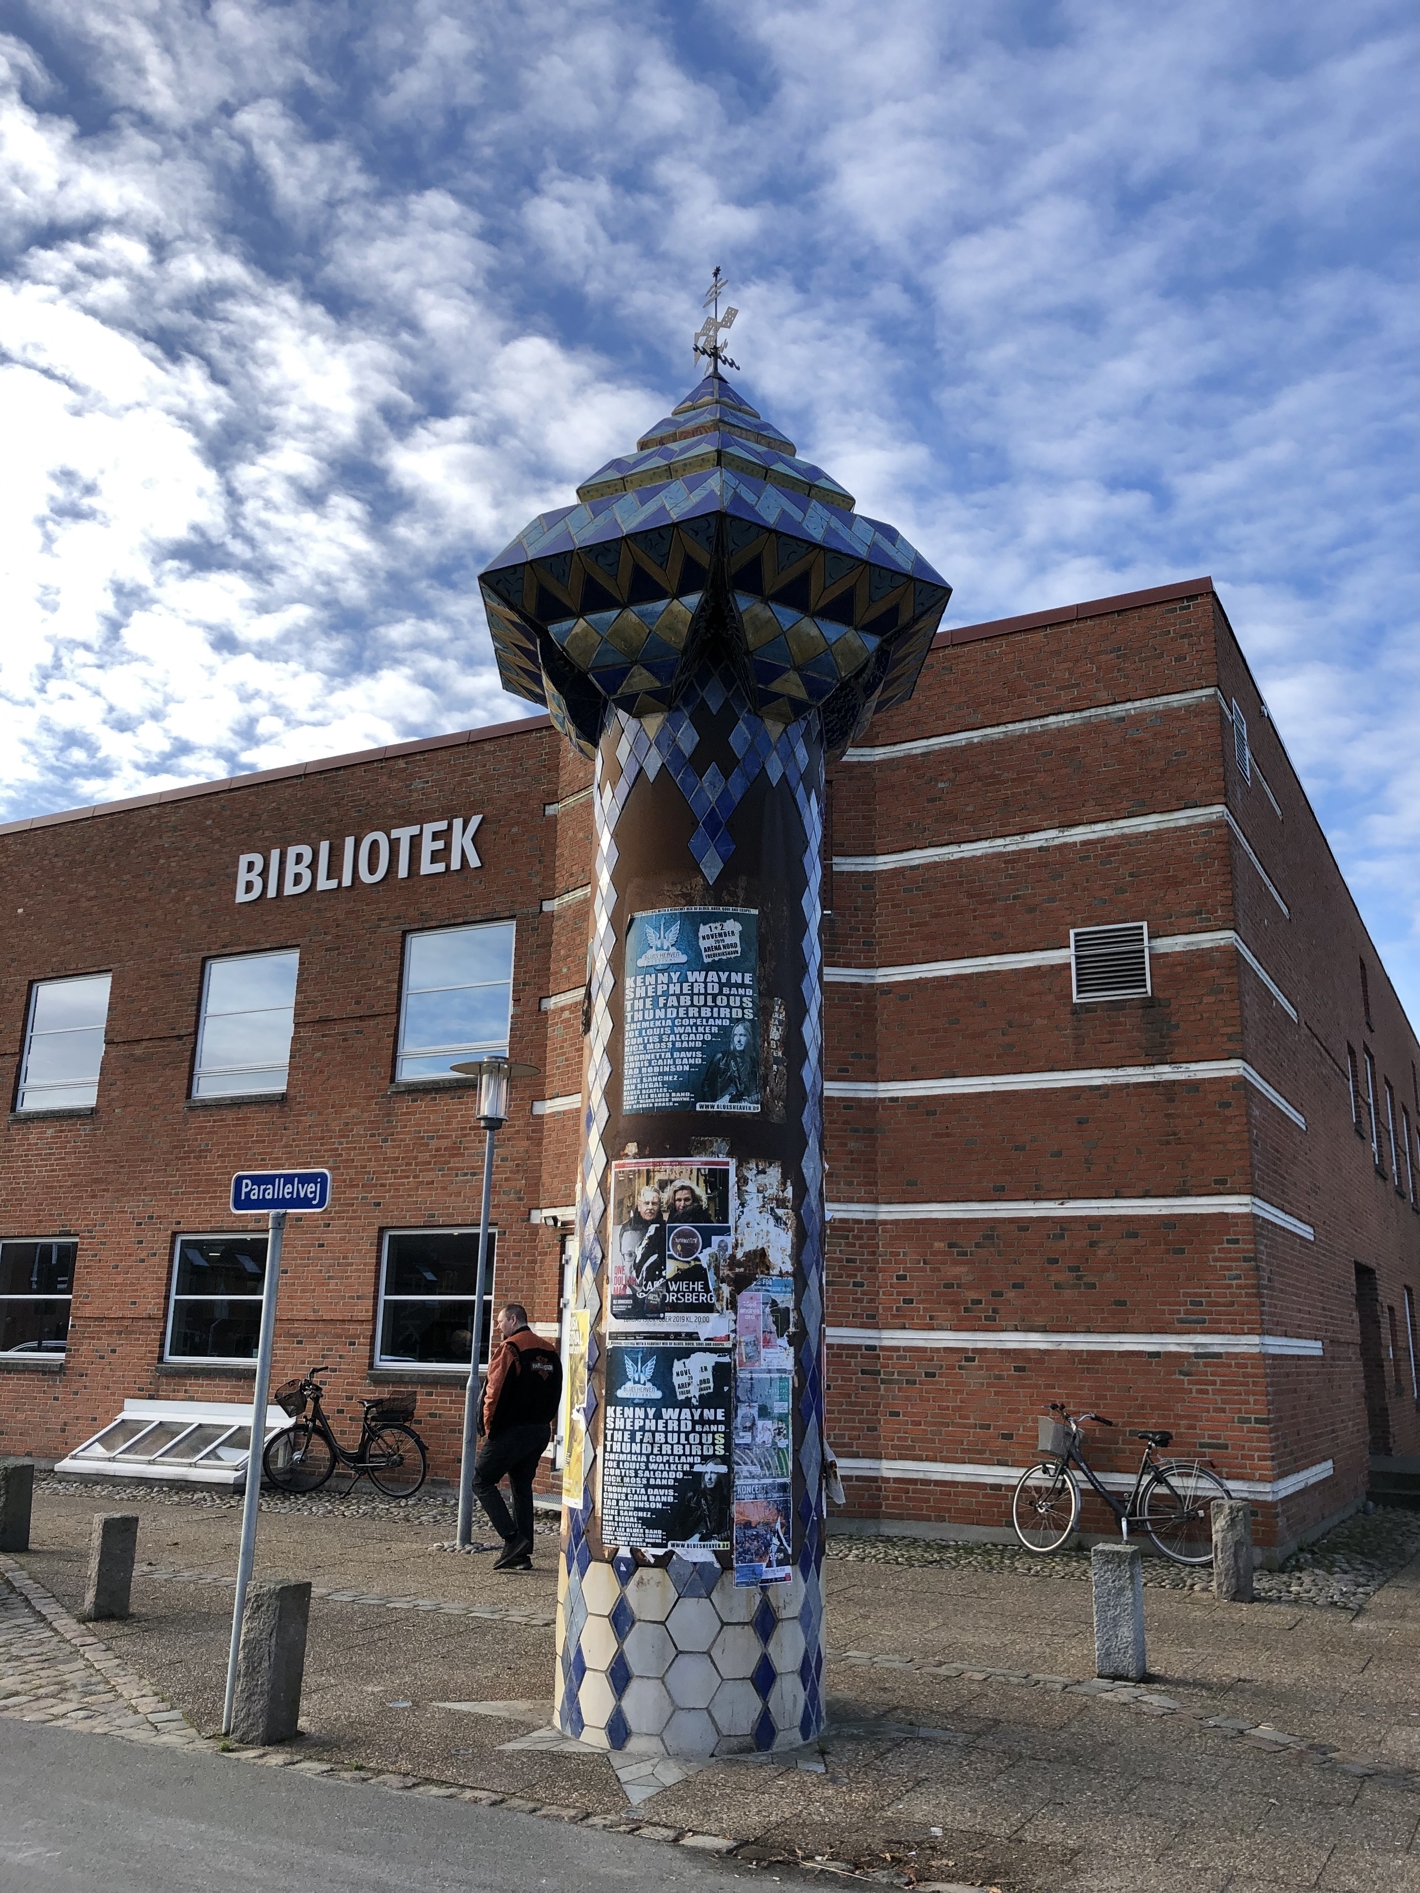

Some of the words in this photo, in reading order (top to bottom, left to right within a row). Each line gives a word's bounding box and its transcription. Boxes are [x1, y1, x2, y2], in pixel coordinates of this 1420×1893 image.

[235, 814, 484, 904] BIBLIOTEK
[720, 923, 725, 931] 2
[702, 930, 736, 941] NOVEMBER
[704, 945, 722, 953] ARENA
[722, 942, 738, 951] NORD
[705, 950, 739, 959] FREDERIKSHAVN
[625, 972, 681, 988] KENNY
[686, 971, 753, 985] WAYNE
[625, 983, 719, 999] SHEPHERD
[722, 987, 753, 995] BAND
[625, 998, 653, 1012] THE
[658, 995, 753, 1008] FABULOUS
[625, 1007, 754, 1023] THUNDERBIRDS
[625, 1020, 672, 1031] SHEMEKIA
[674, 1018, 730, 1026] COPELAND
[625, 1030, 639, 1039] JOE
[642, 1027, 671, 1037] LOUIS
[625, 1034, 659, 1046] CURTIS
[662, 1033, 712, 1042] SALGADO
[625, 1043, 645, 1053] NICK
[647, 1041, 672, 1050] MOSS
[625, 1053, 671, 1063] THORNETTA
[624, 1061, 649, 1069] CHRIS
[624, 1068, 640, 1076] TAD
[641, 1065, 690, 1073] ROBINSON
[241, 1177, 321, 1205] Parallelvej
[668, 1281, 704, 1292] WIEHE
[672, 1315, 685, 1323] 2019
[606, 1406, 656, 1419] KENNY
[661, 1408, 725, 1420] WAYNE
[606, 1418, 692, 1431] SHEPHERD
[695, 1424, 725, 1432] BAND
[605, 1430, 631, 1442] THE
[635, 1432, 725, 1444] FABULOUS
[605, 1441, 725, 1455] THUNDERBIRDS
[604, 1453, 647, 1462] SHEMEKIA
[649, 1455, 701, 1463] COPELAND
[604, 1460, 618, 1468] JOE
[620, 1462, 646, 1470] LOUIS
[648, 1463, 690, 1471] WALKER
[604, 1468, 635, 1477] CURTIS
[637, 1470, 683, 1478] SALGADO
[603, 1475, 622, 1483] NICK
[603, 1485, 646, 1494] THORNETTA
[647, 1488, 674, 1496] DAVIS
[603, 1492, 626, 1500] CHRIS
[619, 1500, 662, 1509] ROBINSON
[620, 1510, 651, 1518] SANCHEZ
[670, 1541, 729, 1549] WWW.BLUESHEAVEN.DK
